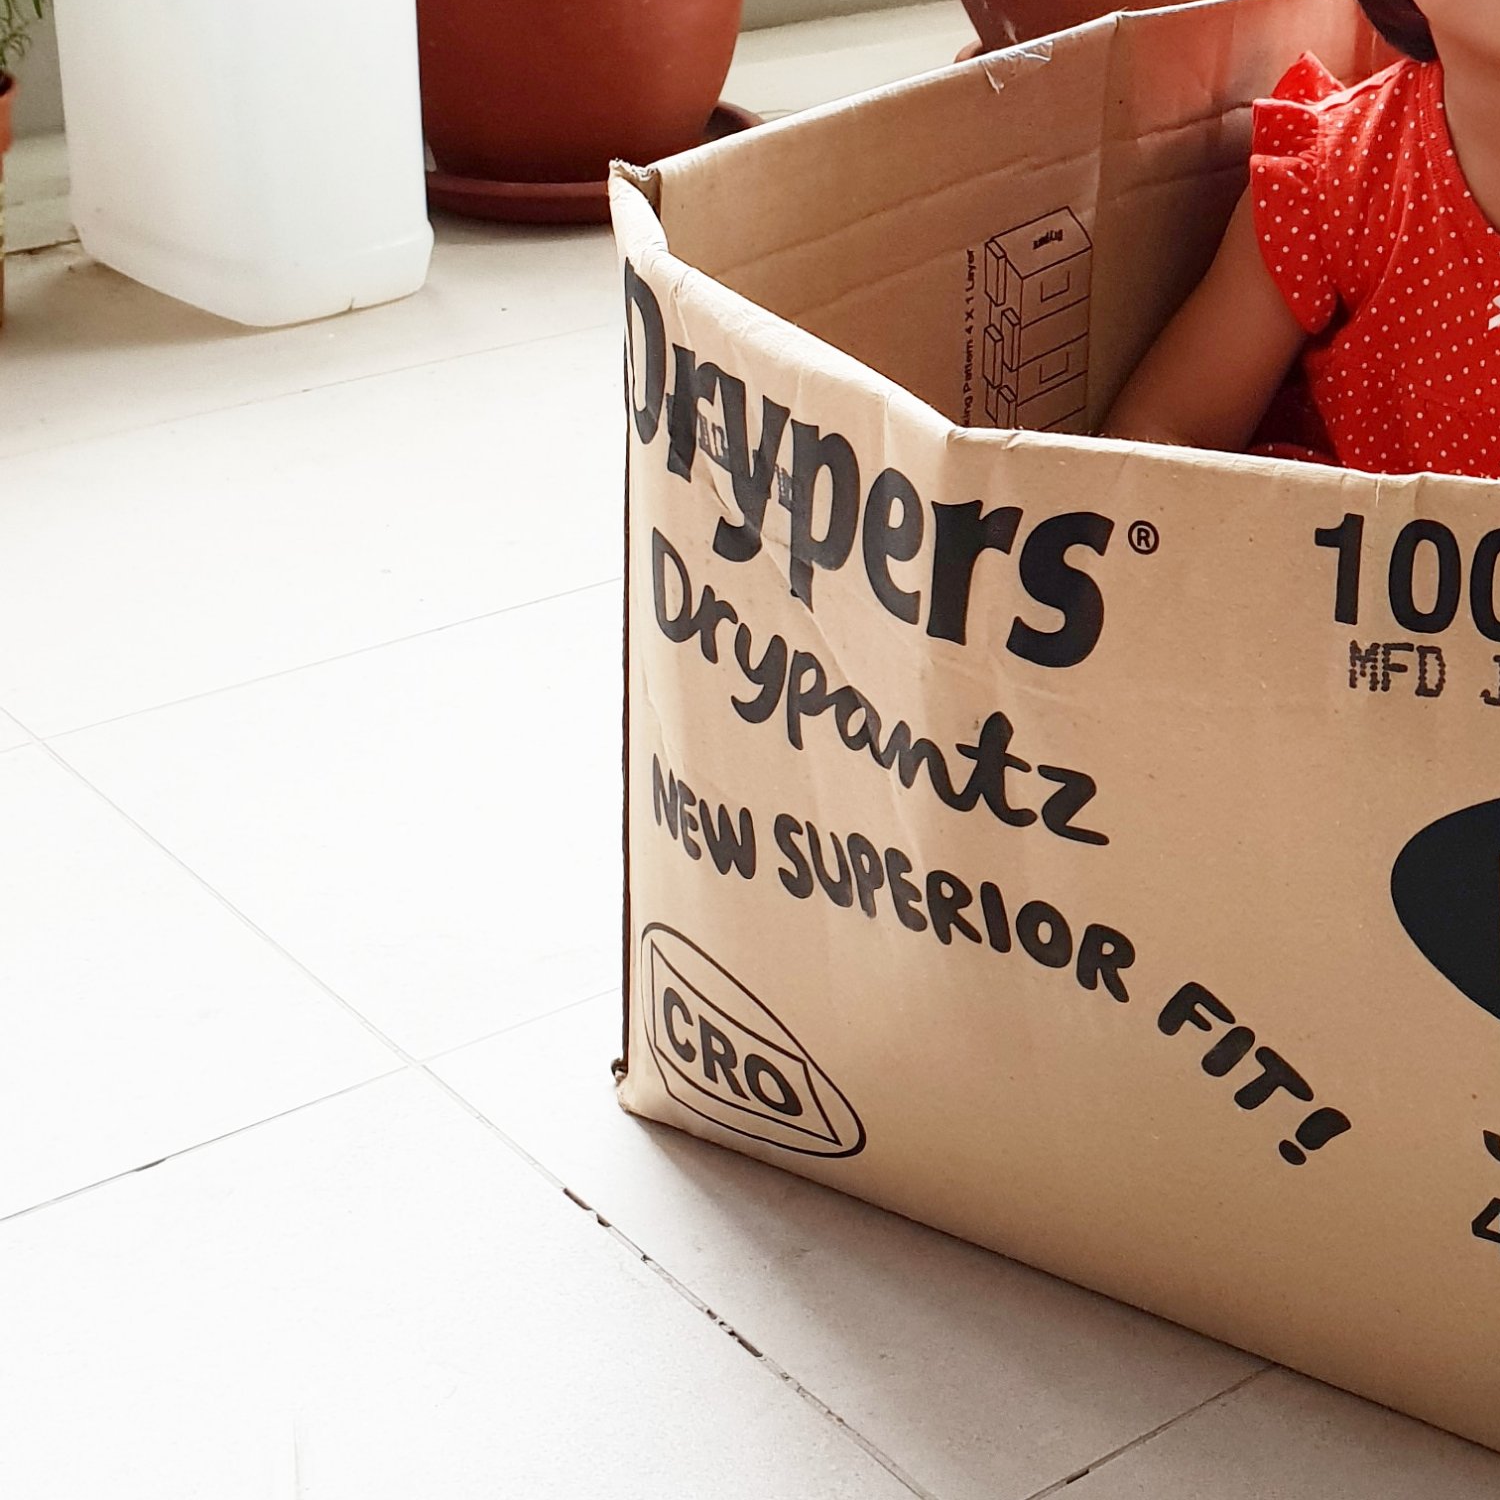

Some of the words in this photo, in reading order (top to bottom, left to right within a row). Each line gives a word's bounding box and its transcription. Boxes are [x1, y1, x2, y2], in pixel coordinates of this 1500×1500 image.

[964, 248, 977, 292] Layer
[964, 325, 974, 335] 4
[652, 526, 1110, 846] Drypantz
[1347, 640, 1446, 699] MFD
[652, 753, 757, 881] NEW
[773, 813, 1137, 1004] SUPERIOR
[1157, 980, 1352, 1167] FIT!
[662, 985, 804, 1117] CRO
